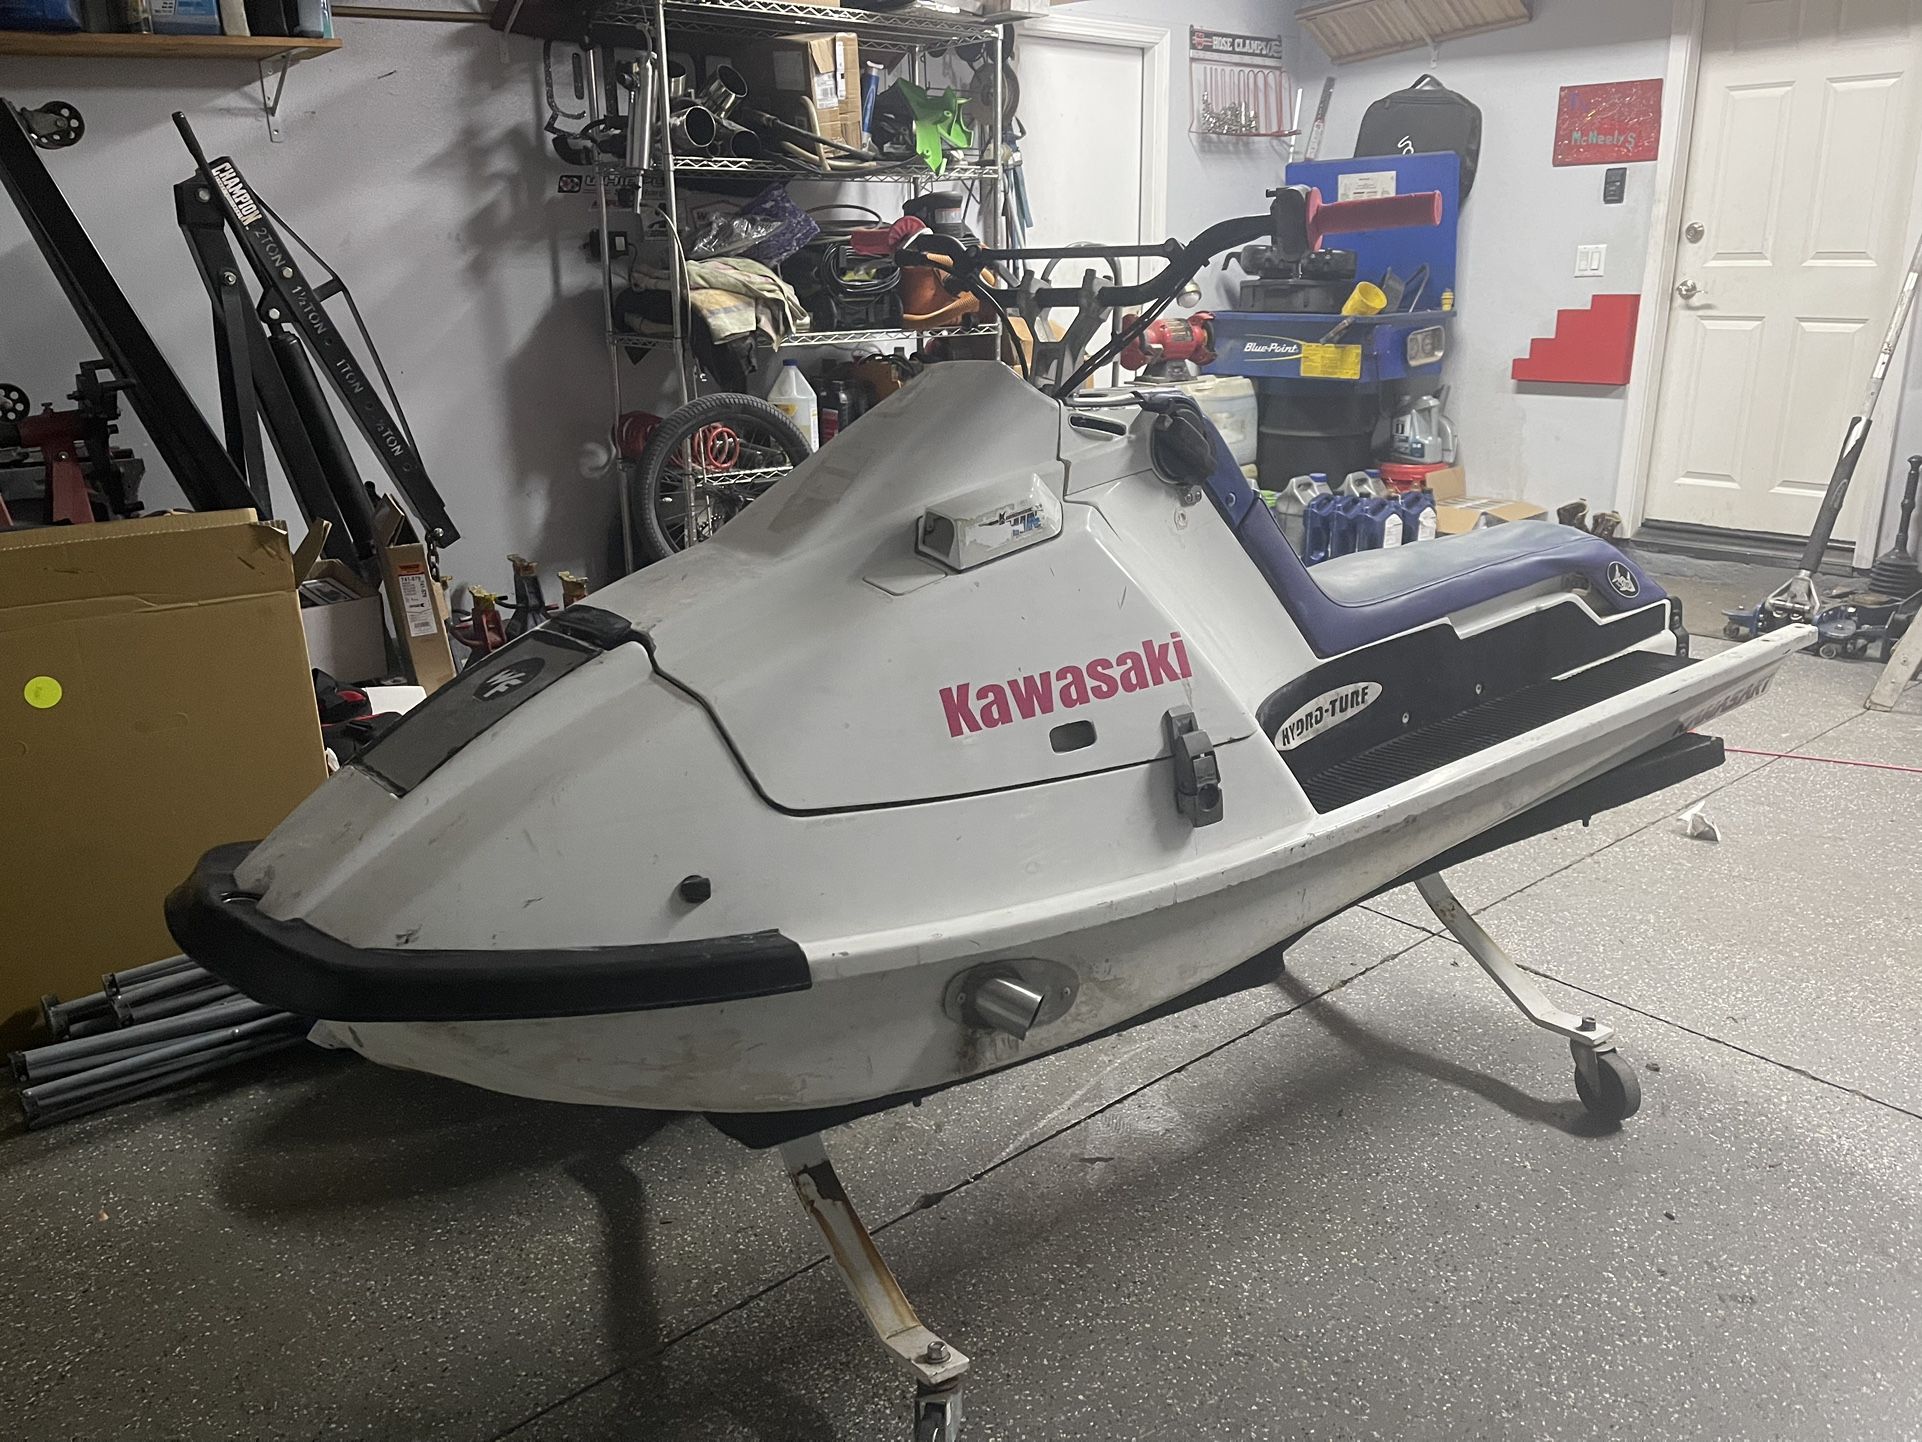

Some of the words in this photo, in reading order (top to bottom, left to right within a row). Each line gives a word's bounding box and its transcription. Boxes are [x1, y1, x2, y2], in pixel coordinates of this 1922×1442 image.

[1212, 36, 1233, 51] HOSE
[1234, 38, 1267, 54] CLAMPS
[211, 162, 262, 227] CHAMPION
[1243, 342, 1298, 353] Blue-Point
[938, 631, 1193, 738] Kawasaki
[1281, 685, 1369, 747] HYDRO-TURF
